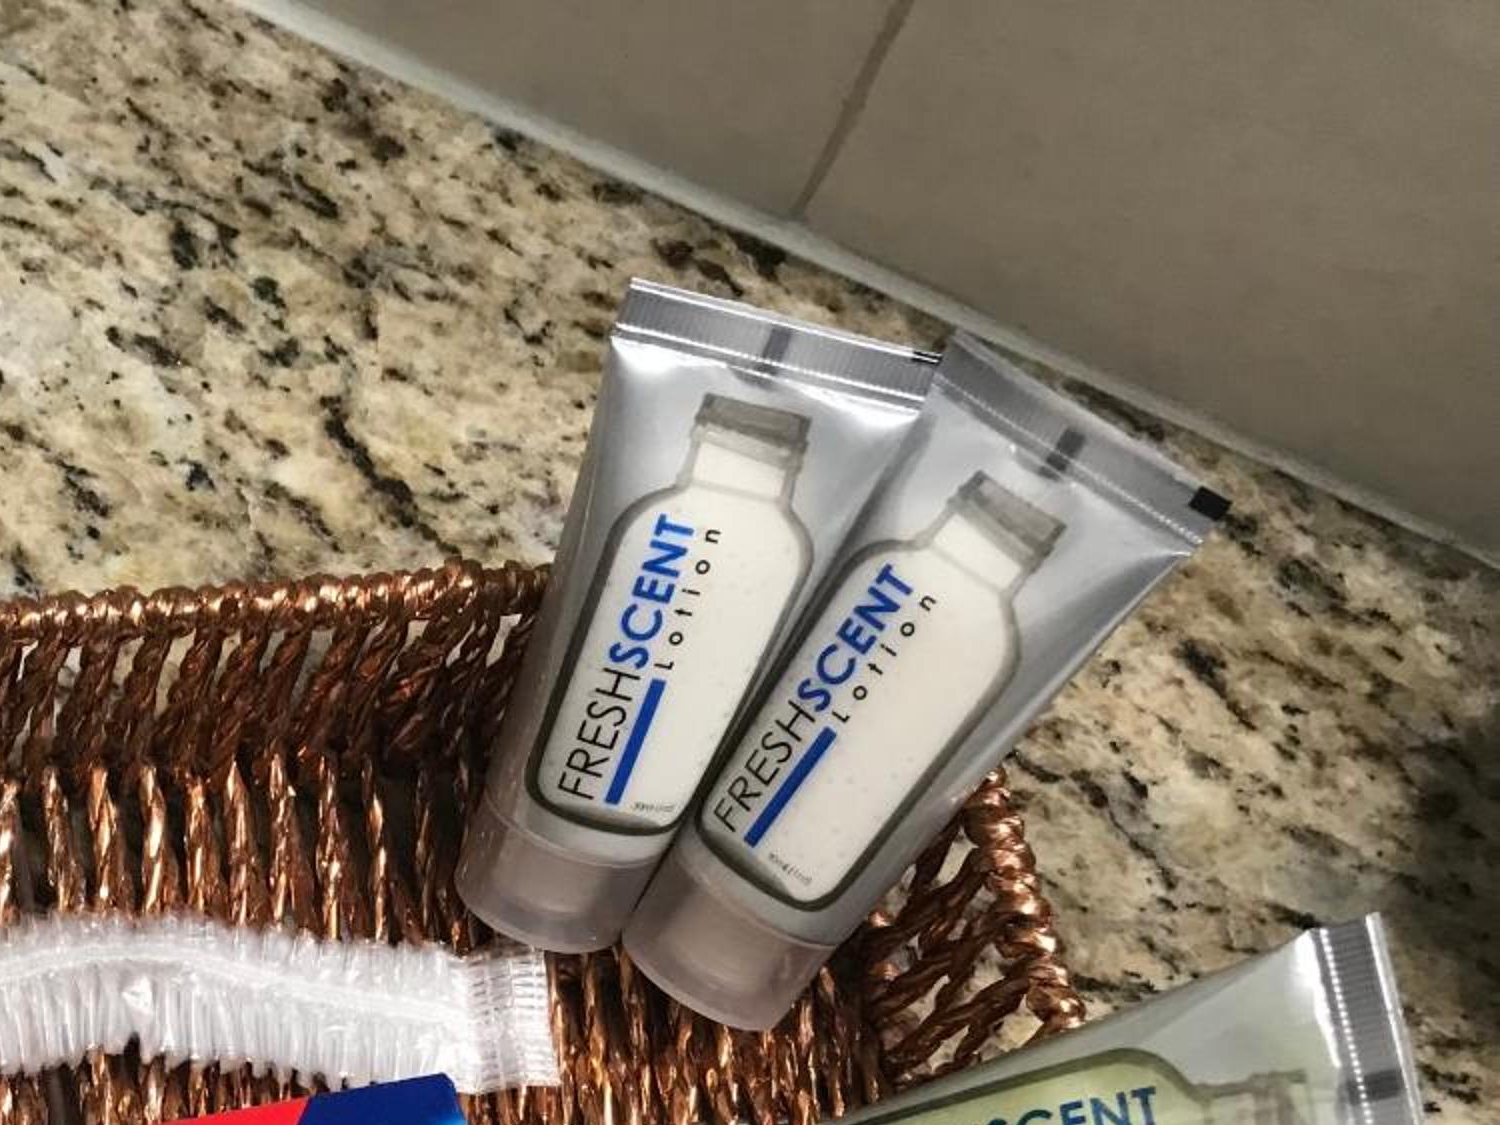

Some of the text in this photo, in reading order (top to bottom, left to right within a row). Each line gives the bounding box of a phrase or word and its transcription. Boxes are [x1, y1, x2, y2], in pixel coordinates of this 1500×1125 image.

[558, 513, 695, 800] FRESHSCENT
[654, 528, 722, 671] Lotion
[713, 563, 914, 833] FRESHSCENT
[831, 594, 937, 724] Lotion
